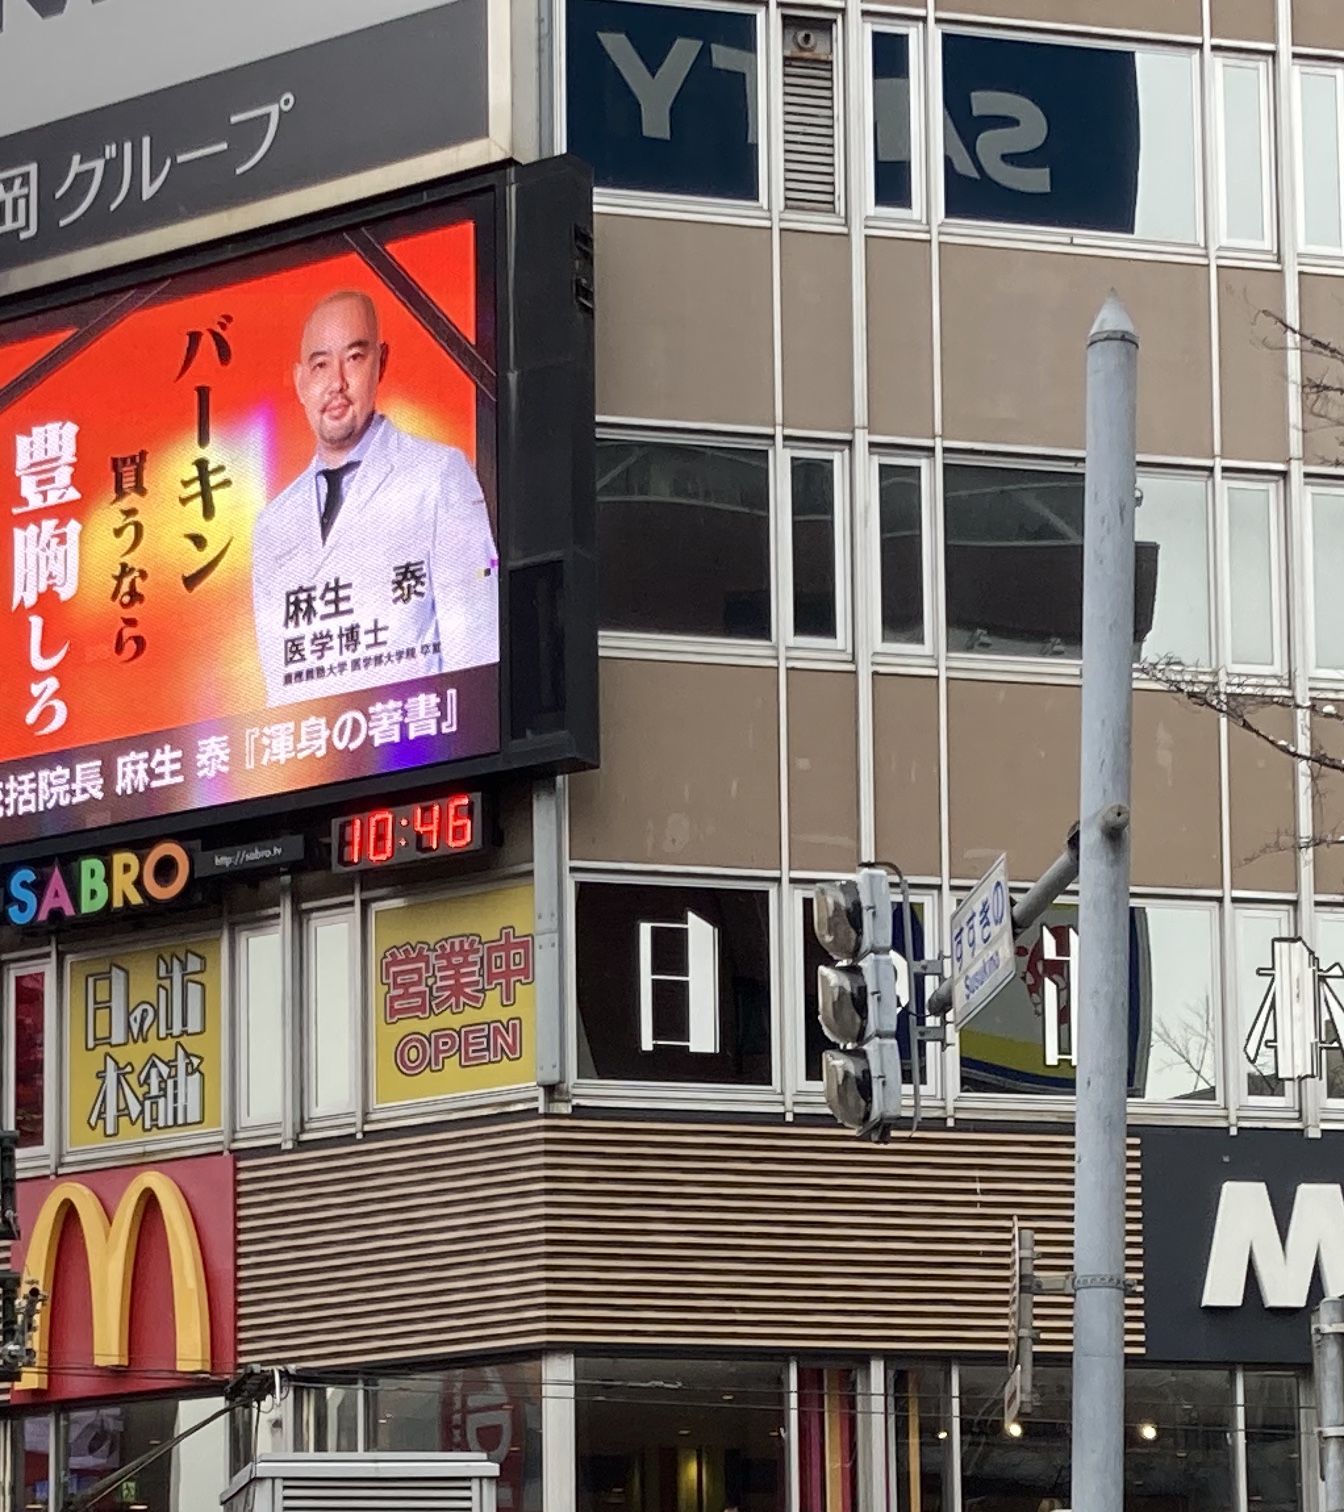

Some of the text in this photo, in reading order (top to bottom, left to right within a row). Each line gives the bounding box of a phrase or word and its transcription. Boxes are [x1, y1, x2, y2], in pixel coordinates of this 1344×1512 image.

[175, 312, 234, 593] バーキン
[10, 421, 83, 738] 豊胸しろ
[110, 449, 148, 664] 買うなら
[283, 559, 427, 630] 麻生 泰
[283, 618, 389, 668] 医学博士
[115, 747, 185, 792] 麻生
[196, 738, 231, 776] 泰
[244, 688, 458, 770] 『渾身の著書』
[348, 794, 472, 864] 10:46
[7, 840, 190, 925] SABRO
[954, 879, 1005, 973] すすきの
[85, 948, 207, 1051] 日の出
[380, 924, 535, 1025] 営業中
[88, 1043, 206, 1138] 本舗
[394, 1017, 523, 1078] OPEN
